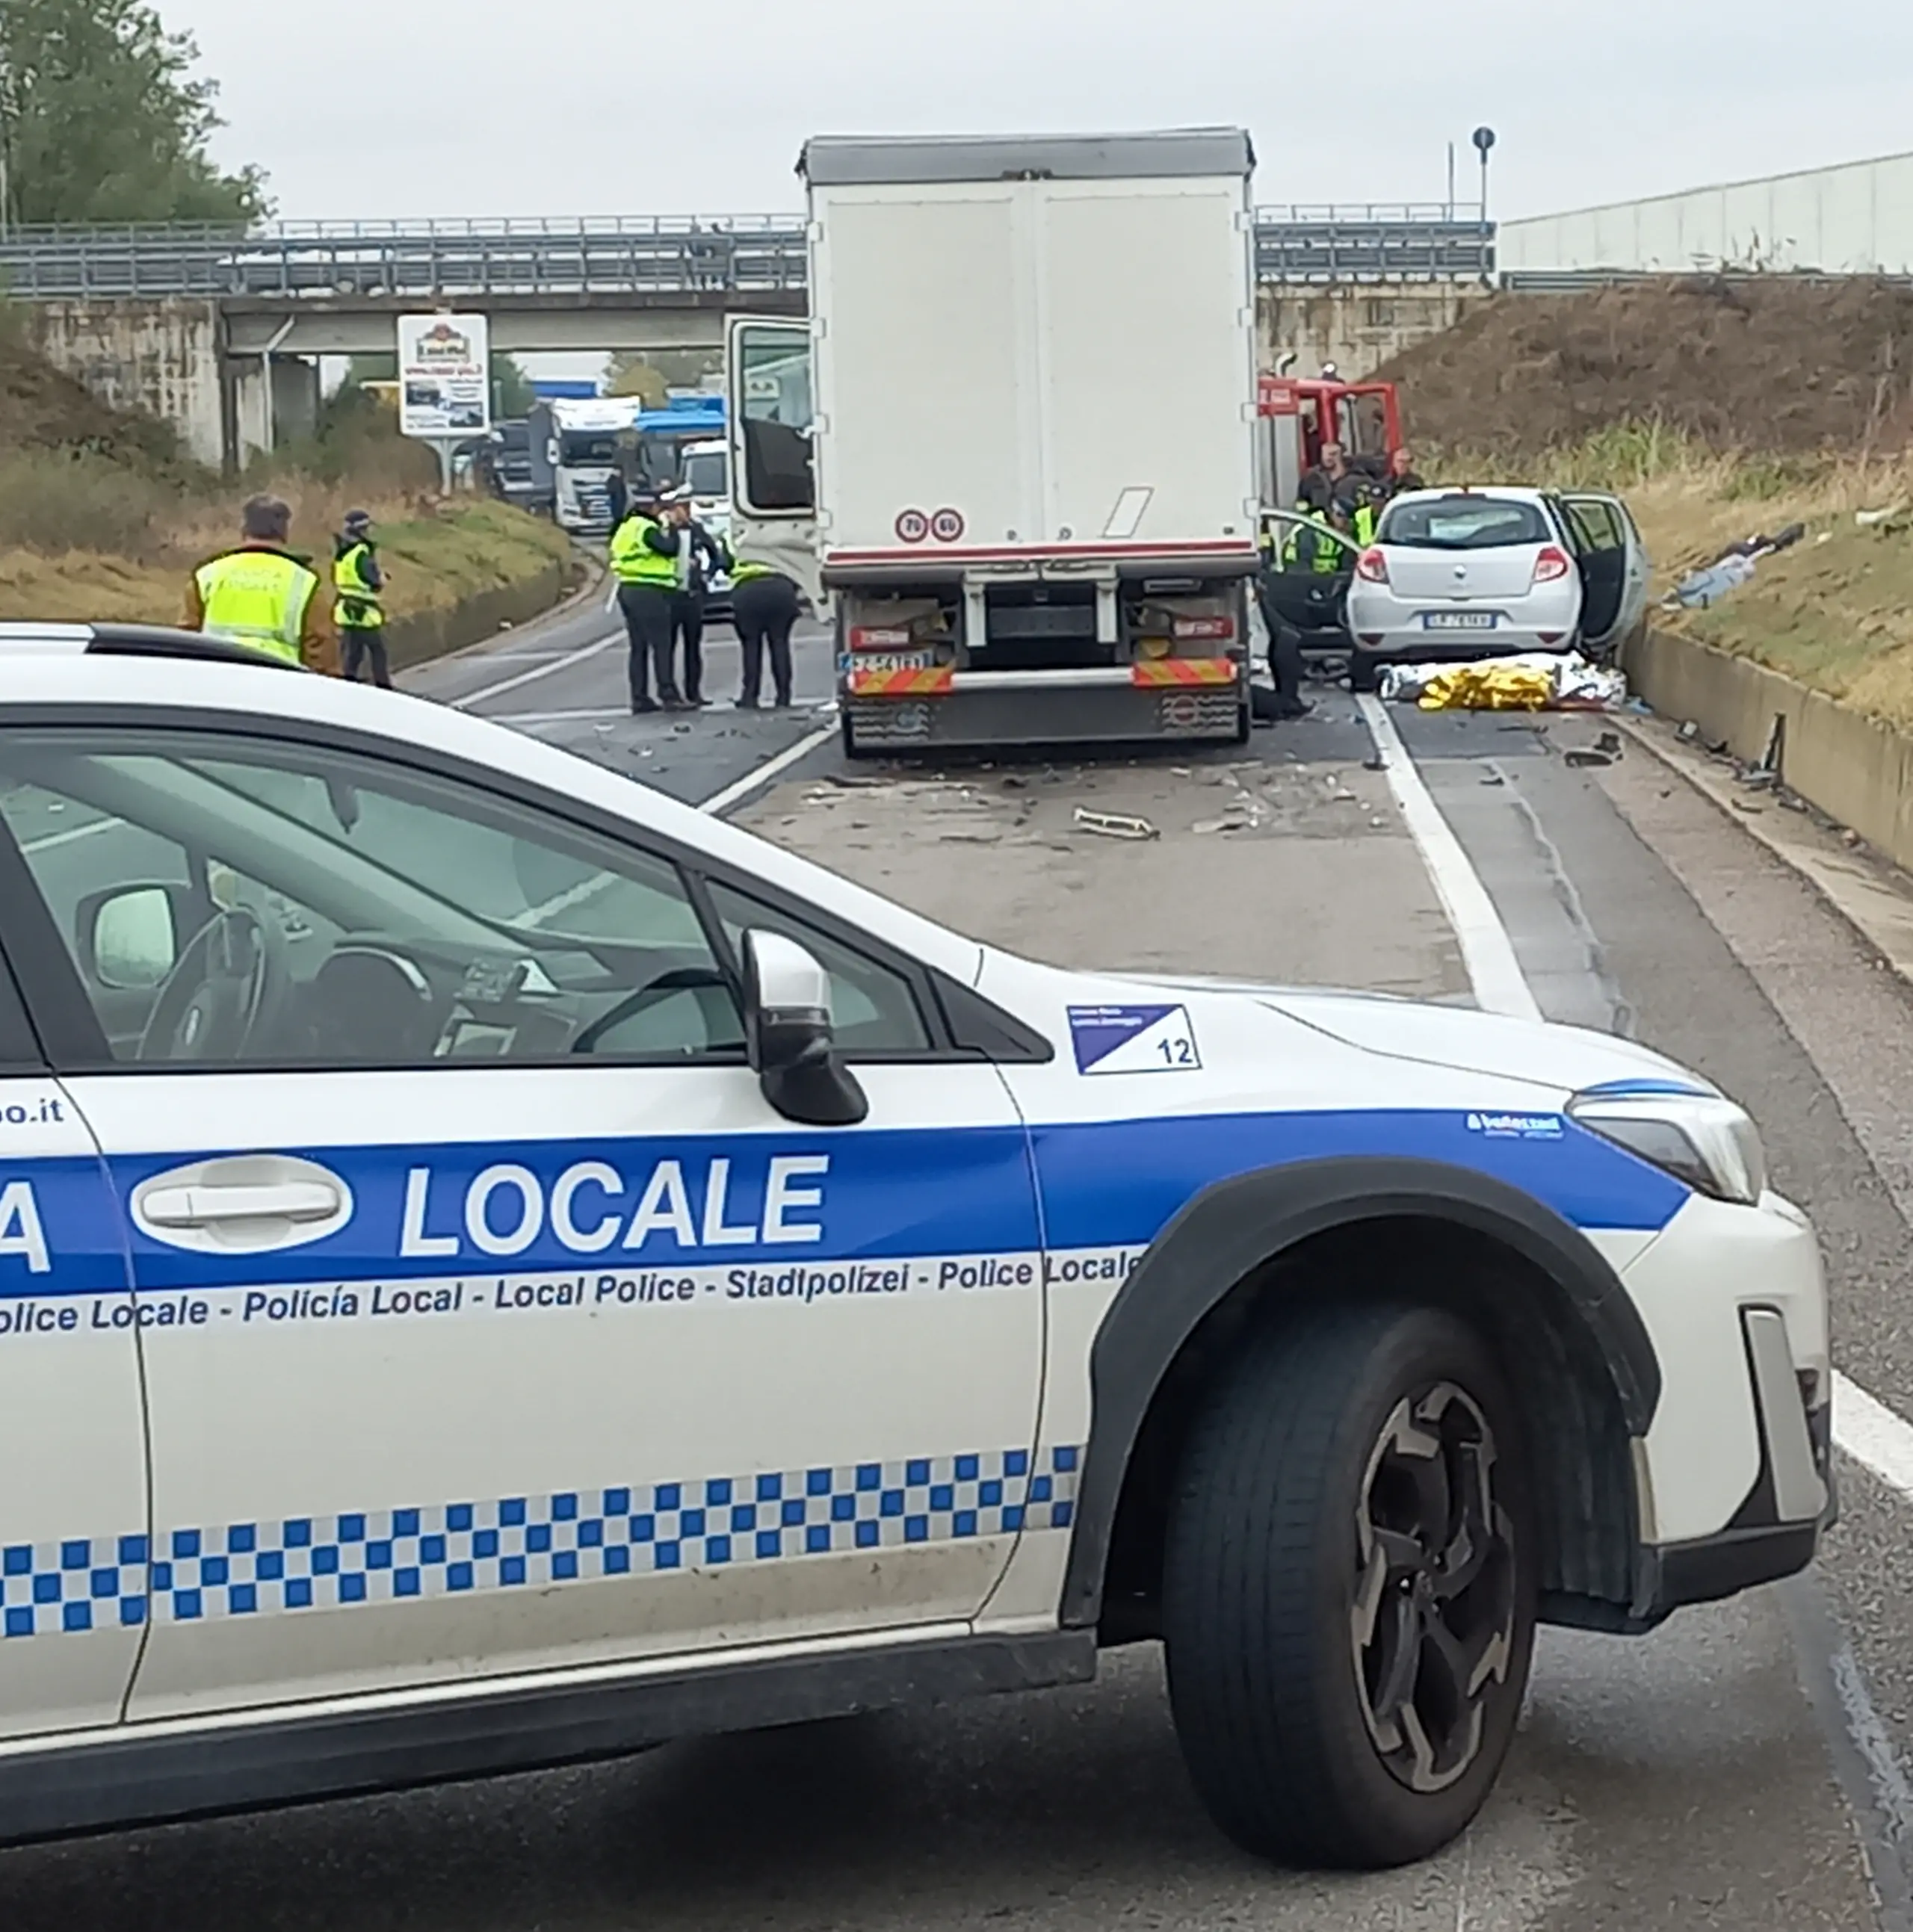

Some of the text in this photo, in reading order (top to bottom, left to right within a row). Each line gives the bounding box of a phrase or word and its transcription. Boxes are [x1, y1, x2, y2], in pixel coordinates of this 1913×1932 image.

[1157, 1038, 1193, 1064] 12
[0, 1098, 65, 1124] o.it
[400, 1154, 829, 1257] LOCALE
[91, 1295, 209, 1328] Locale
[243, 1284, 359, 1322] Policía
[371, 1281, 463, 1315] Local
[495, 1276, 585, 1309] Local
[595, 1272, 696, 1304] Police
[938, 1259, 1033, 1290] Police
